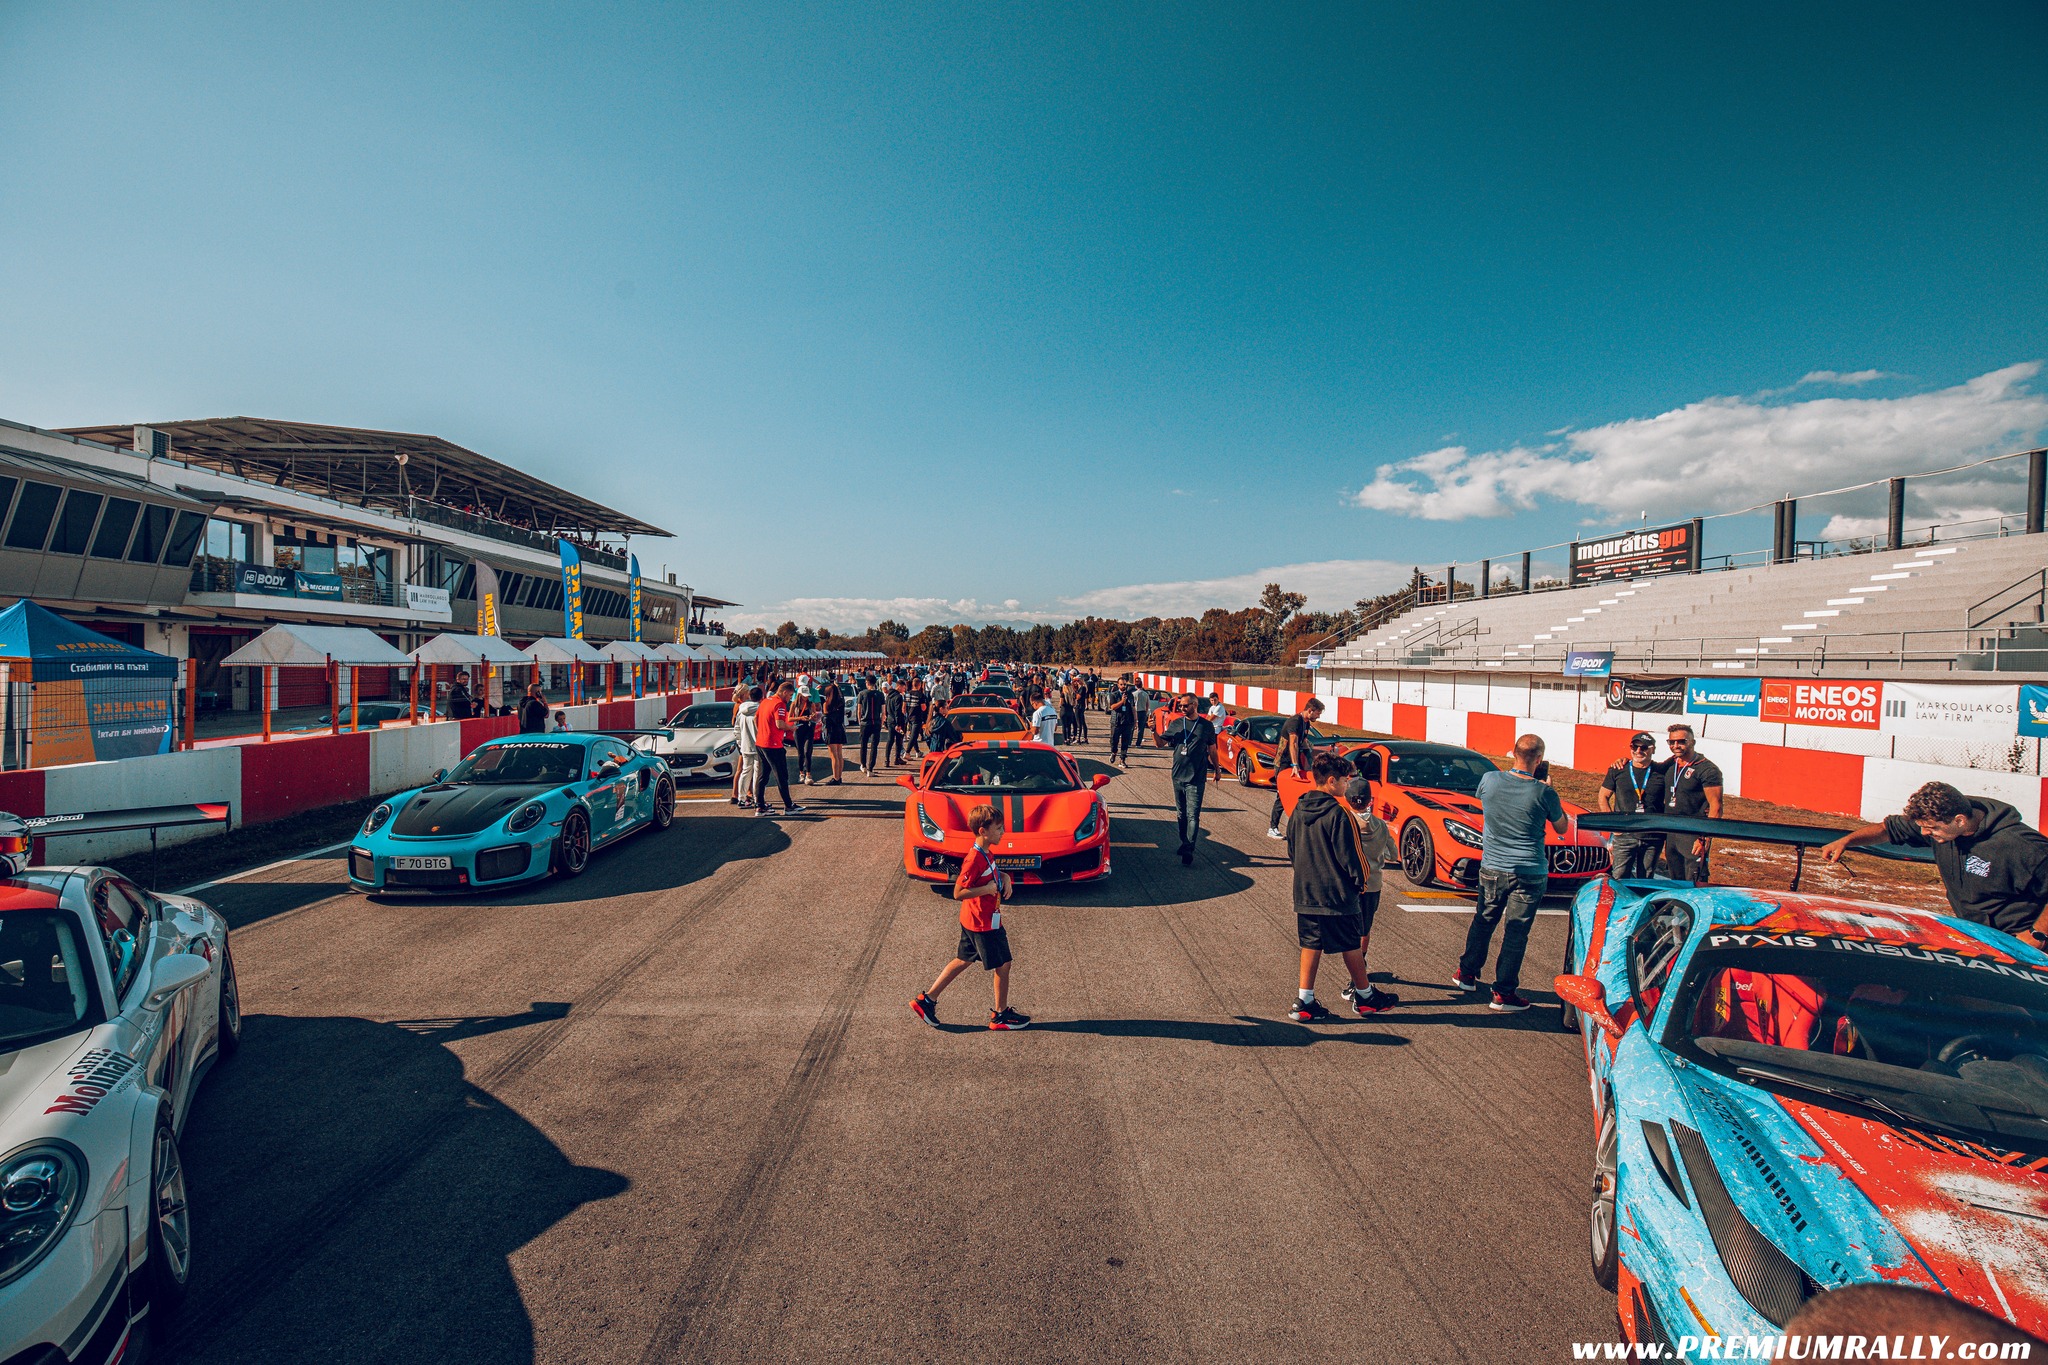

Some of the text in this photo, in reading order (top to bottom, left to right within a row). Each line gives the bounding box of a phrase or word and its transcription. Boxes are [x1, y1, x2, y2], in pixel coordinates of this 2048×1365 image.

[257, 574, 286, 586] BODY
[309, 584, 340, 592] MICHELIN
[70, 663, 112, 673] Стабилни
[127, 663, 149, 672] пътя!
[1581, 659, 1605, 668] BODY
[1707, 693, 1756, 703] MICHELIN
[1767, 696, 1789, 704] ENEOS
[1796, 685, 1877, 707] ENEOS
[1916, 701, 2013, 714] MARKOULAKOS
[1795, 706, 1876, 723] MOTOR OIL
[1916, 711, 1974, 722] LAW FIRM
[409, 858, 421, 868] 70
[425, 858, 447, 869] BTG
[1709, 934, 1817, 947] PYXIS
[43, 1050, 139, 1117] Molinari
